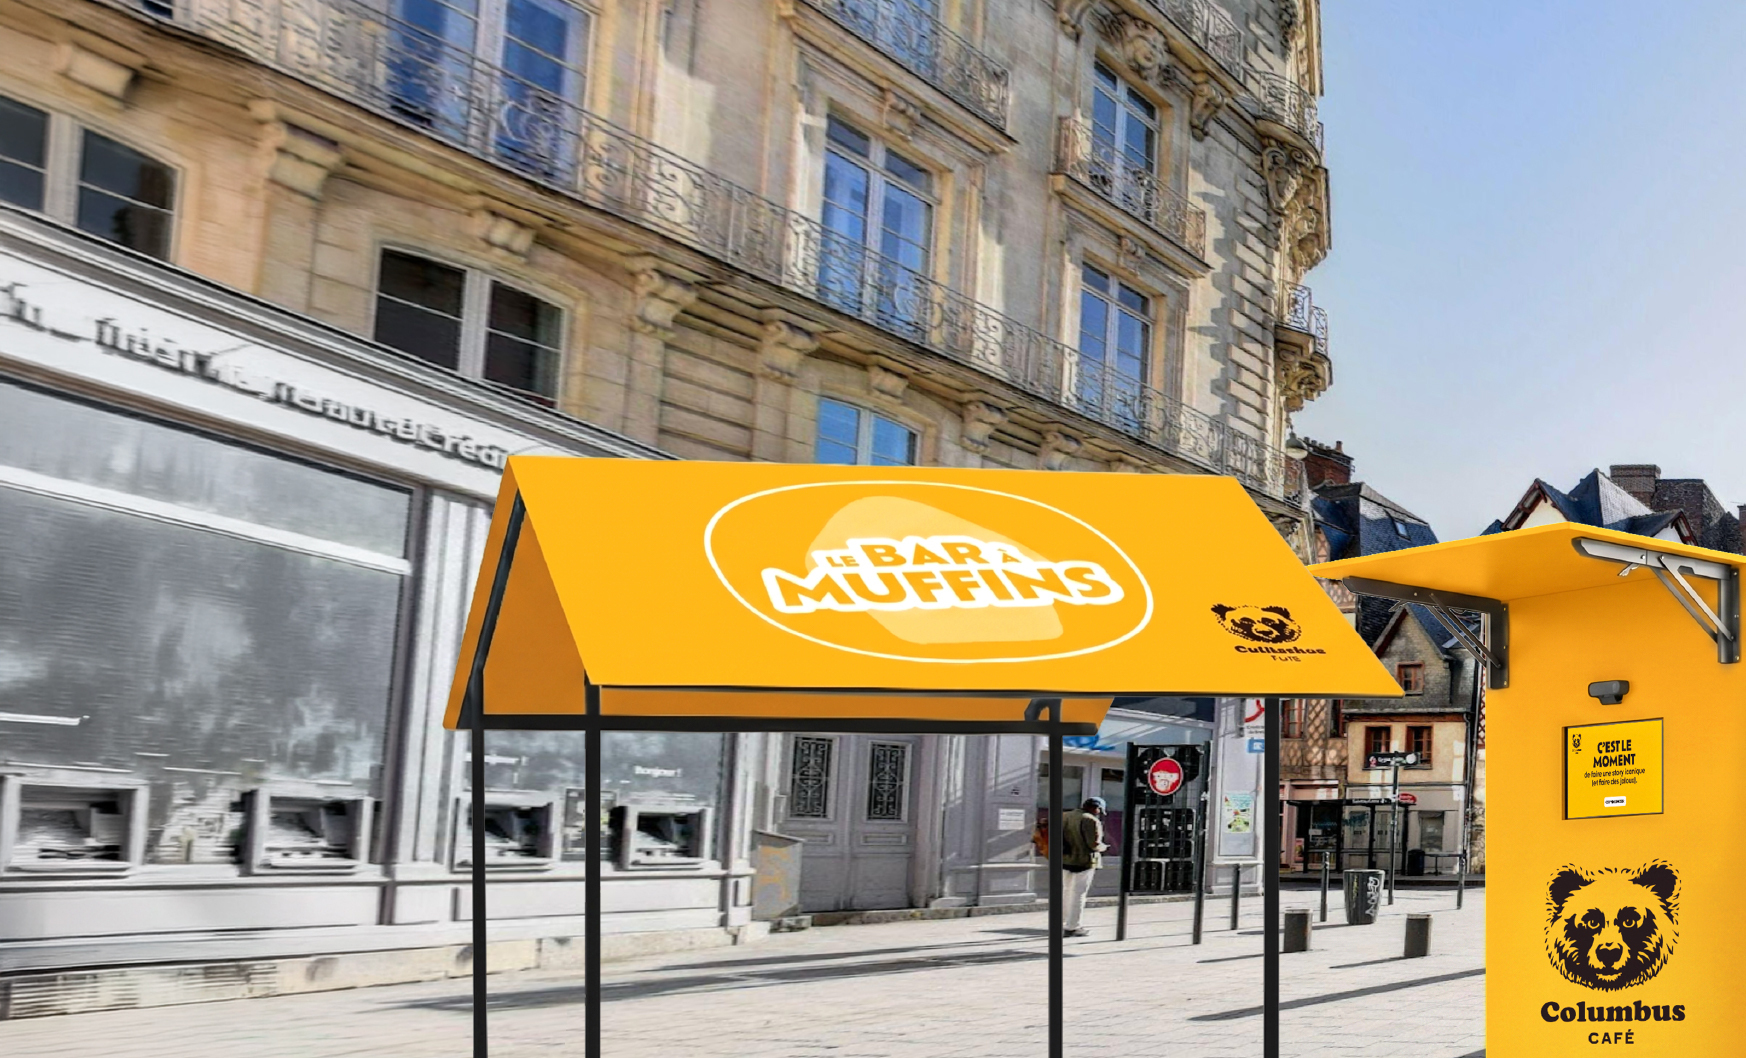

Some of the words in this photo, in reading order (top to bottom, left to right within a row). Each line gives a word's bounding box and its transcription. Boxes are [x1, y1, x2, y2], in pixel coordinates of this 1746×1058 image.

[826, 555, 859, 568] LE
[860, 541, 989, 567] BAR
[997, 547, 1022, 563] À
[774, 564, 1112, 607] MUFFINS
[1597, 740, 1620, 754] C'EST
[1621, 739, 1632, 752] LE
[1592, 753, 1636, 768] MOMENT
[1591, 769, 1602, 778] faire
[1611, 768, 1624, 777] story
[1624, 767, 1646, 776] iconique
[1540, 1000, 1686, 1023] Columbus
[1588, 1029, 1635, 1044] CAFÉ
